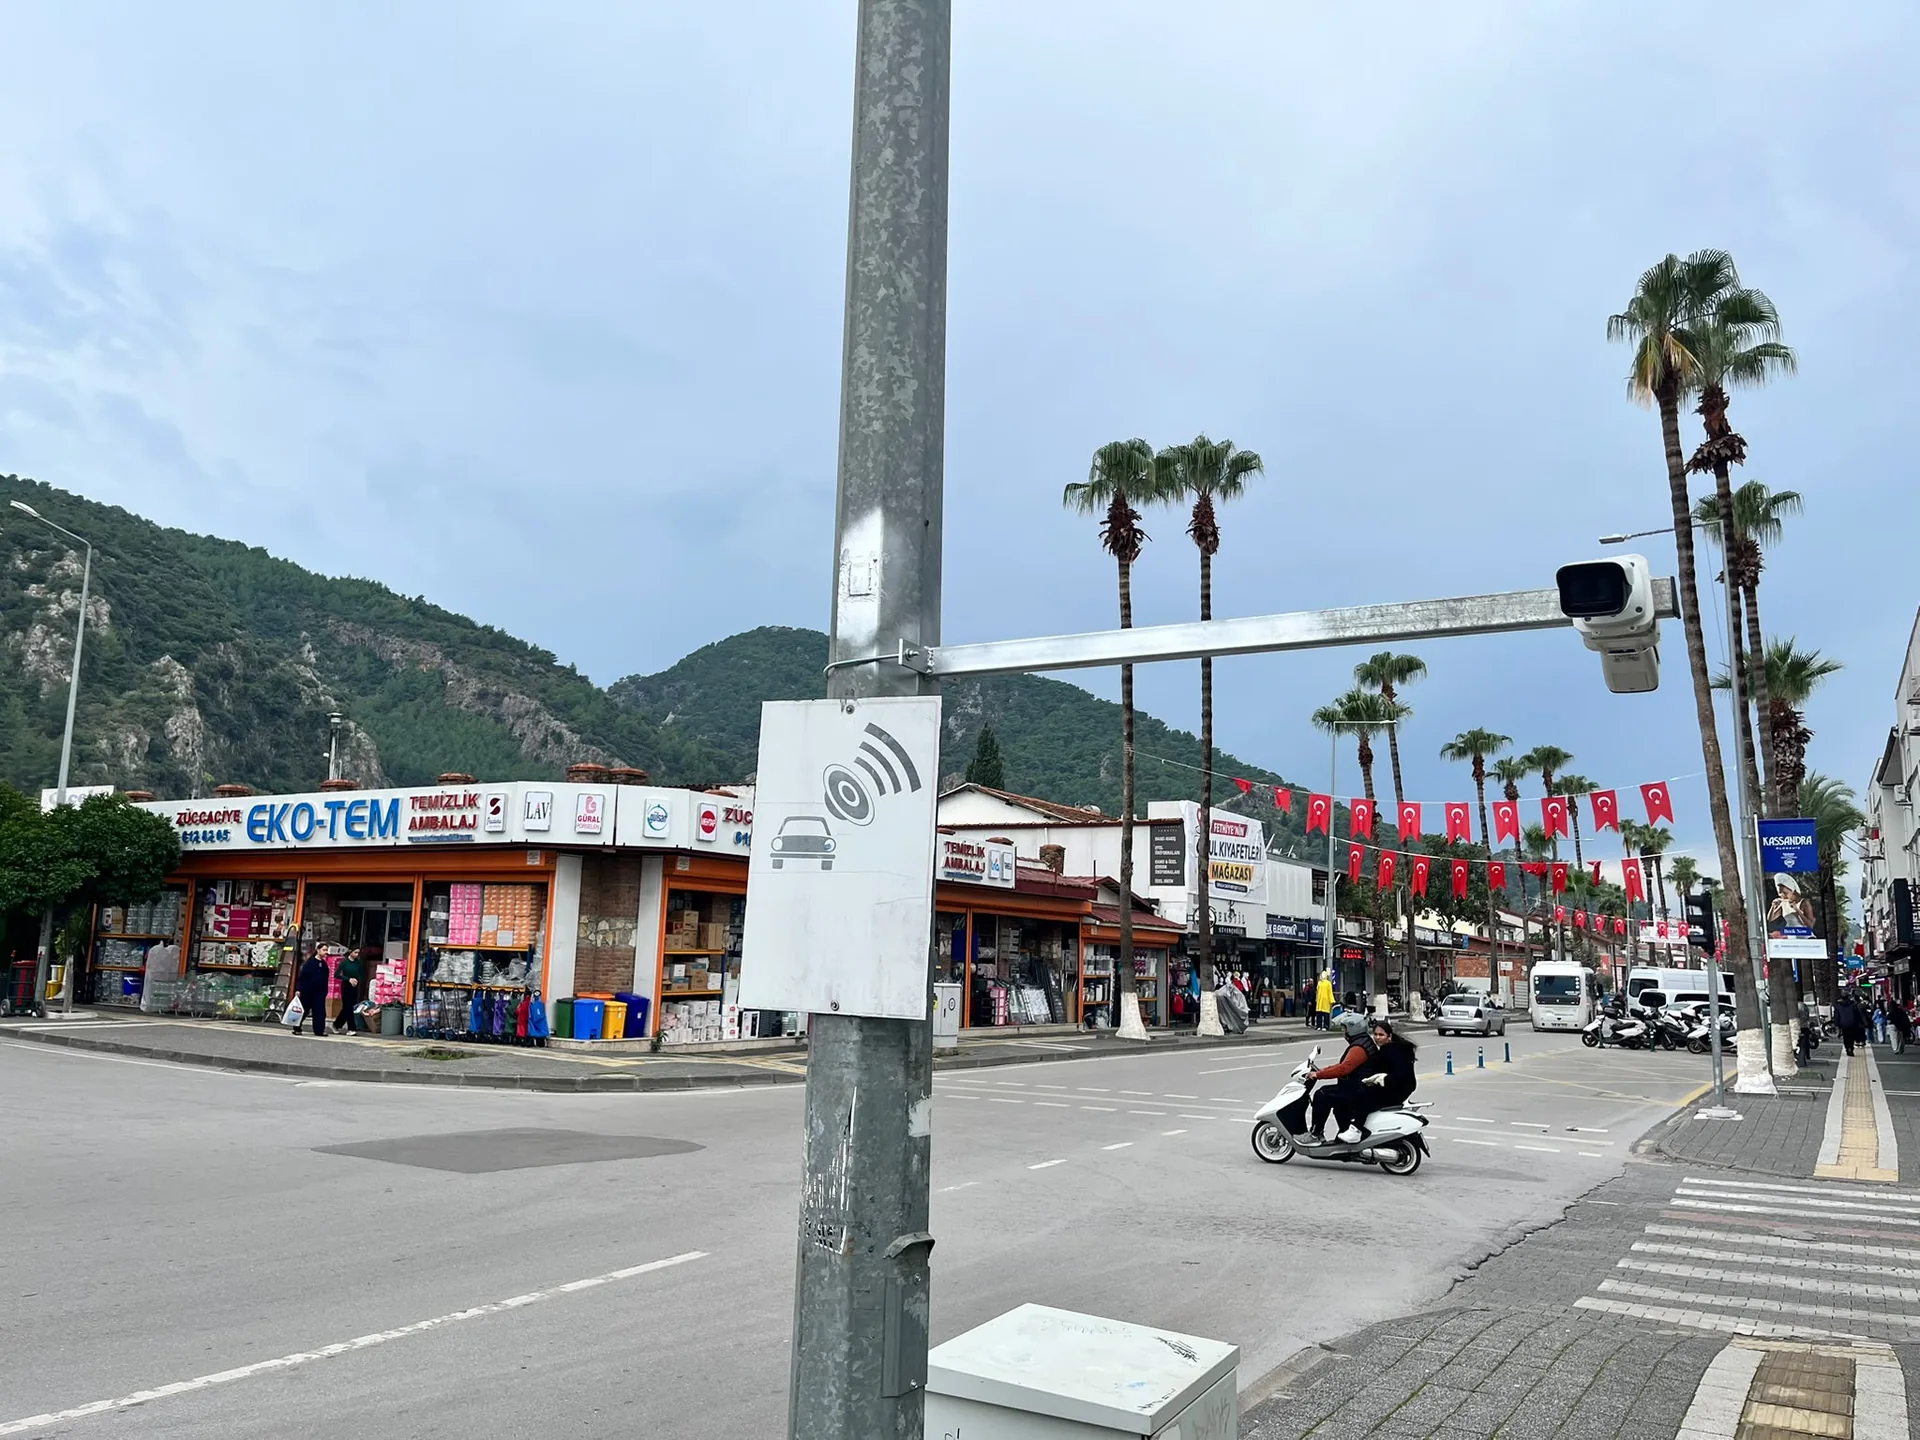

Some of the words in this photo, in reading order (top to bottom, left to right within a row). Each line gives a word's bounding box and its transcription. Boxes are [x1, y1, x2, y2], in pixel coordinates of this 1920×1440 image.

[409, 789, 480, 810] TEMİZLİK
[175, 805, 242, 826] ZÜCCACİYE
[247, 797, 402, 842] EKO-TEM
[525, 801, 550, 820] LAV
[577, 814, 601, 823] GÜRAL
[408, 814, 478, 831] AMBALAJ
[943, 840, 986, 859] TEMİZLİK
[1762, 835, 1813, 847] KASSANDRA
[941, 855, 986, 873] AMBALAJ
[1211, 863, 1252, 881] MAĞAZASI
